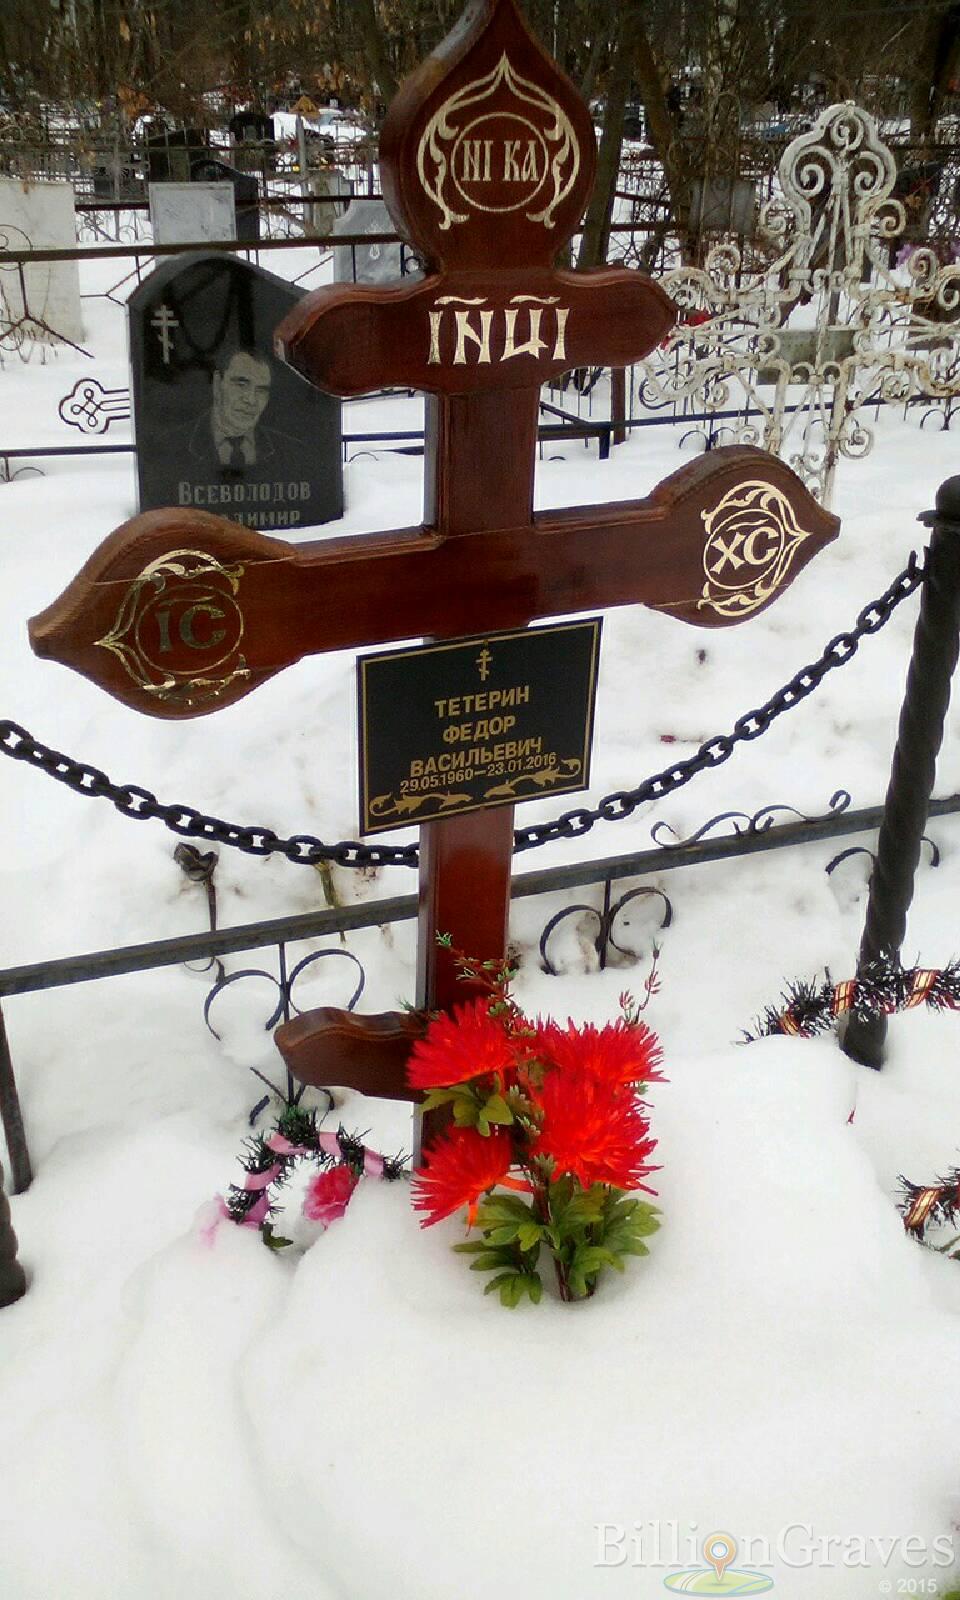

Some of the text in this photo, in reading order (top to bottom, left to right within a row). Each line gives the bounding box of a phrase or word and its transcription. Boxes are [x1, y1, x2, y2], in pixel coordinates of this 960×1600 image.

[434, 685, 530, 718] ТЕТЕРИН
[442, 715, 517, 745] ФЕДОР
[409, 736, 543, 778] ВАСИЛЬЕВИЧ
